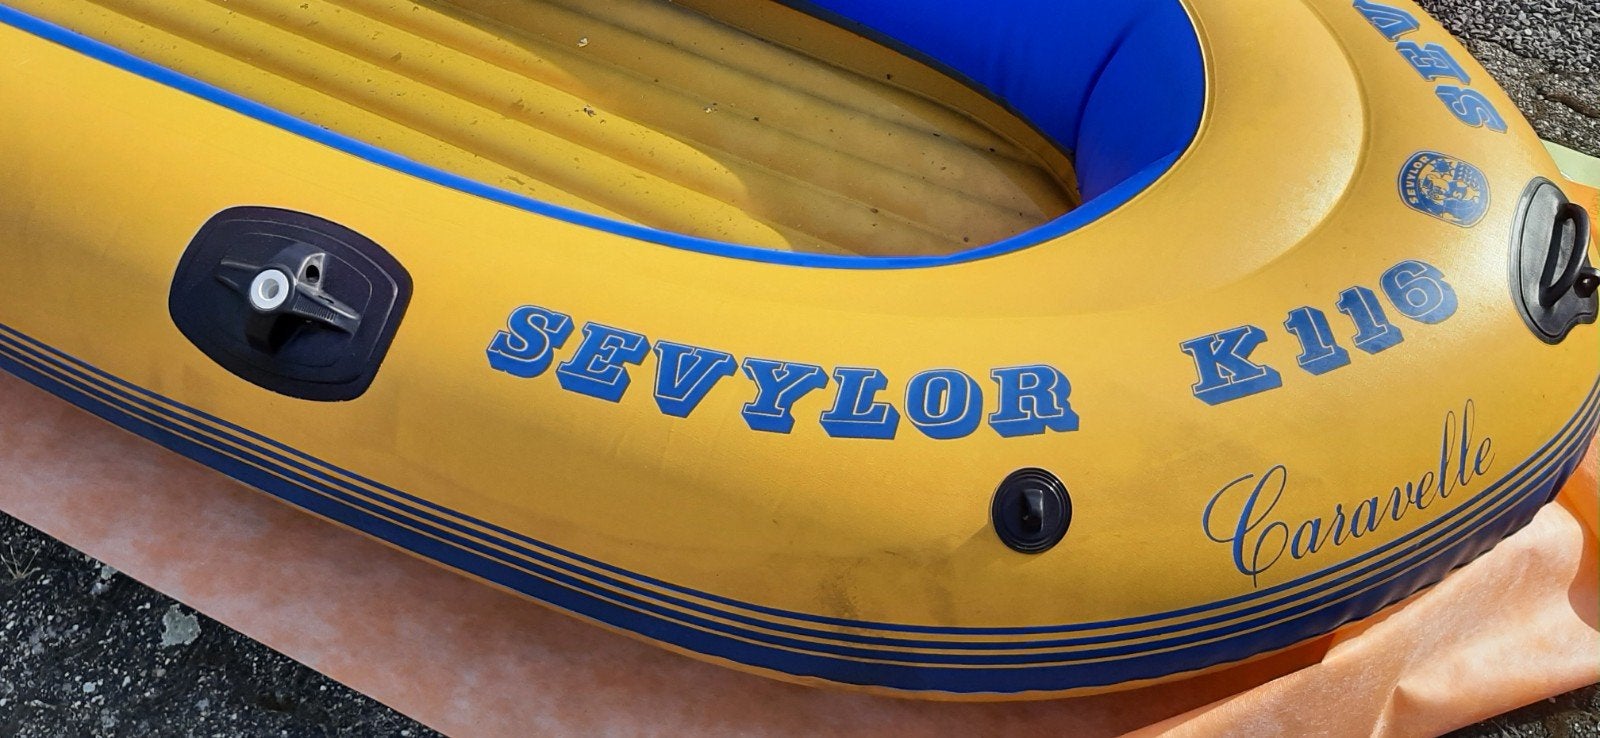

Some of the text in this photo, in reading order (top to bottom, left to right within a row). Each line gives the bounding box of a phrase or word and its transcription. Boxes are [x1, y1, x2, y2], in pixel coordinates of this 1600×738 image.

[1405, 155, 1430, 204] SEVYLOR
[485, 304, 1080, 440] SEVYLOR
[1178, 259, 1459, 406] K 116
[1202, 398, 1497, 588] Caravelle
